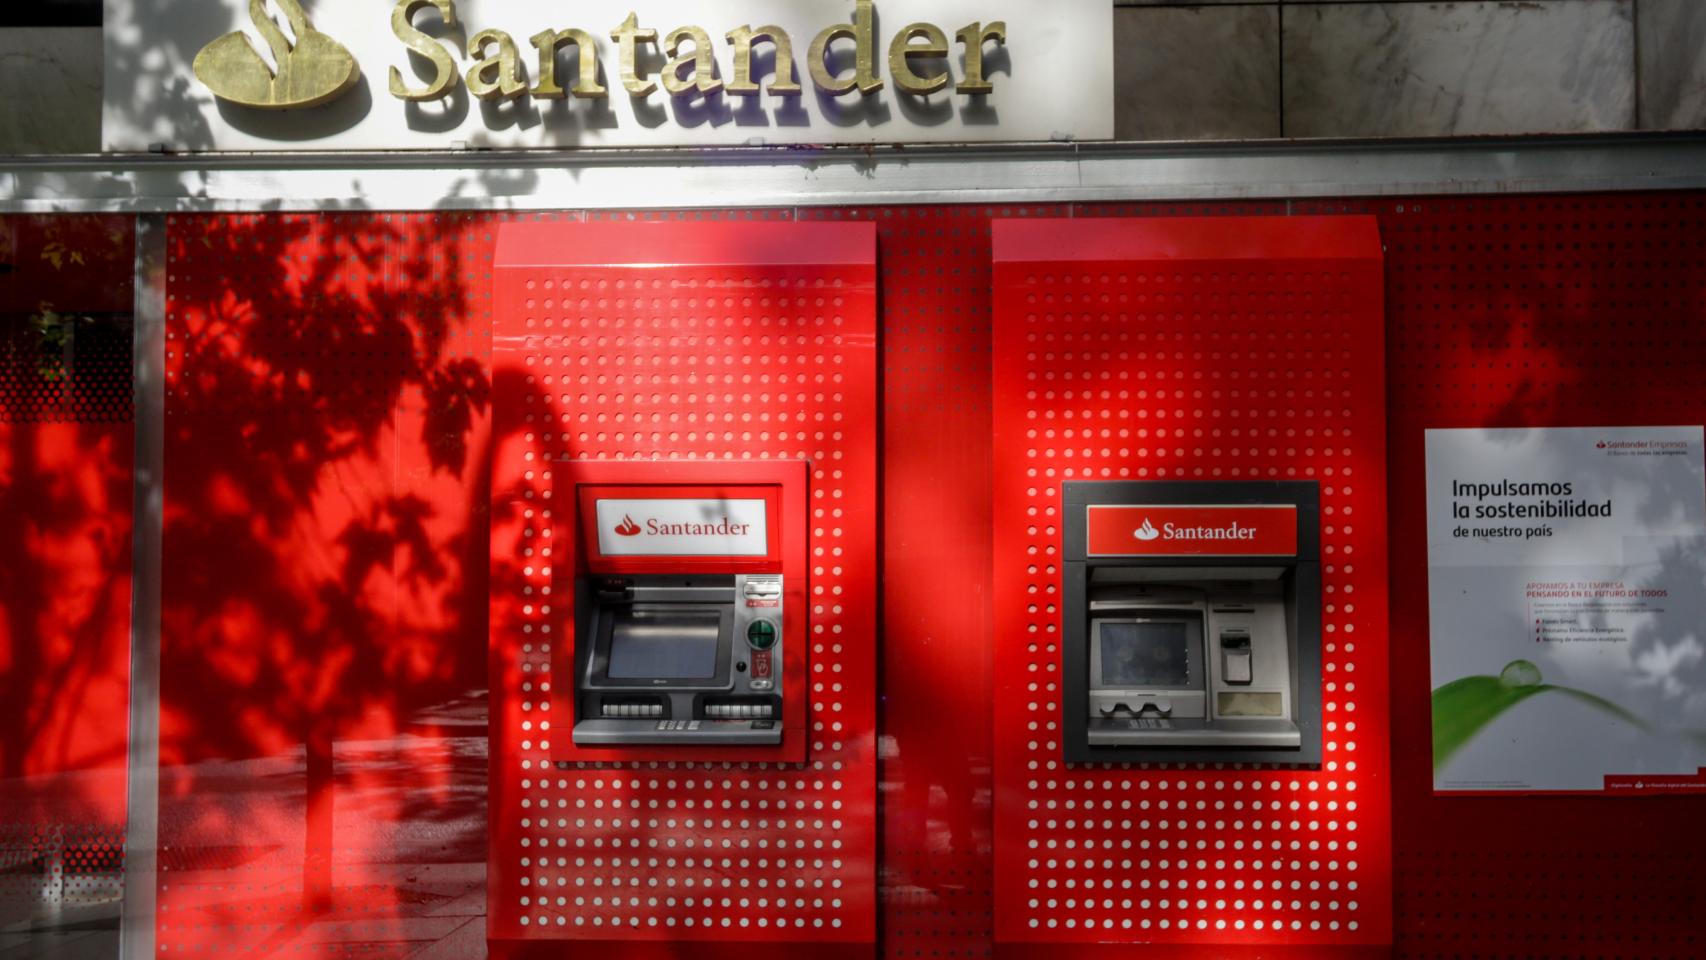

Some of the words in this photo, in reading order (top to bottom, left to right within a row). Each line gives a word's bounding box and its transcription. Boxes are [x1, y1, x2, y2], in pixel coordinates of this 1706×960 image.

[388, 0, 1006, 100] Santander
[1607, 440, 1648, 449] Santander
[1649, 441, 1688, 450] Empresas
[1453, 479, 1573, 501] Impulsamos
[1453, 501, 1470, 519] la
[1475, 499, 1612, 519] sostenibilidad
[646, 516, 750, 536] Santander
[1163, 521, 1257, 540] Santander
[1453, 525, 1469, 538] de
[1473, 525, 1522, 538] nuestro
[1526, 524, 1553, 540] país
